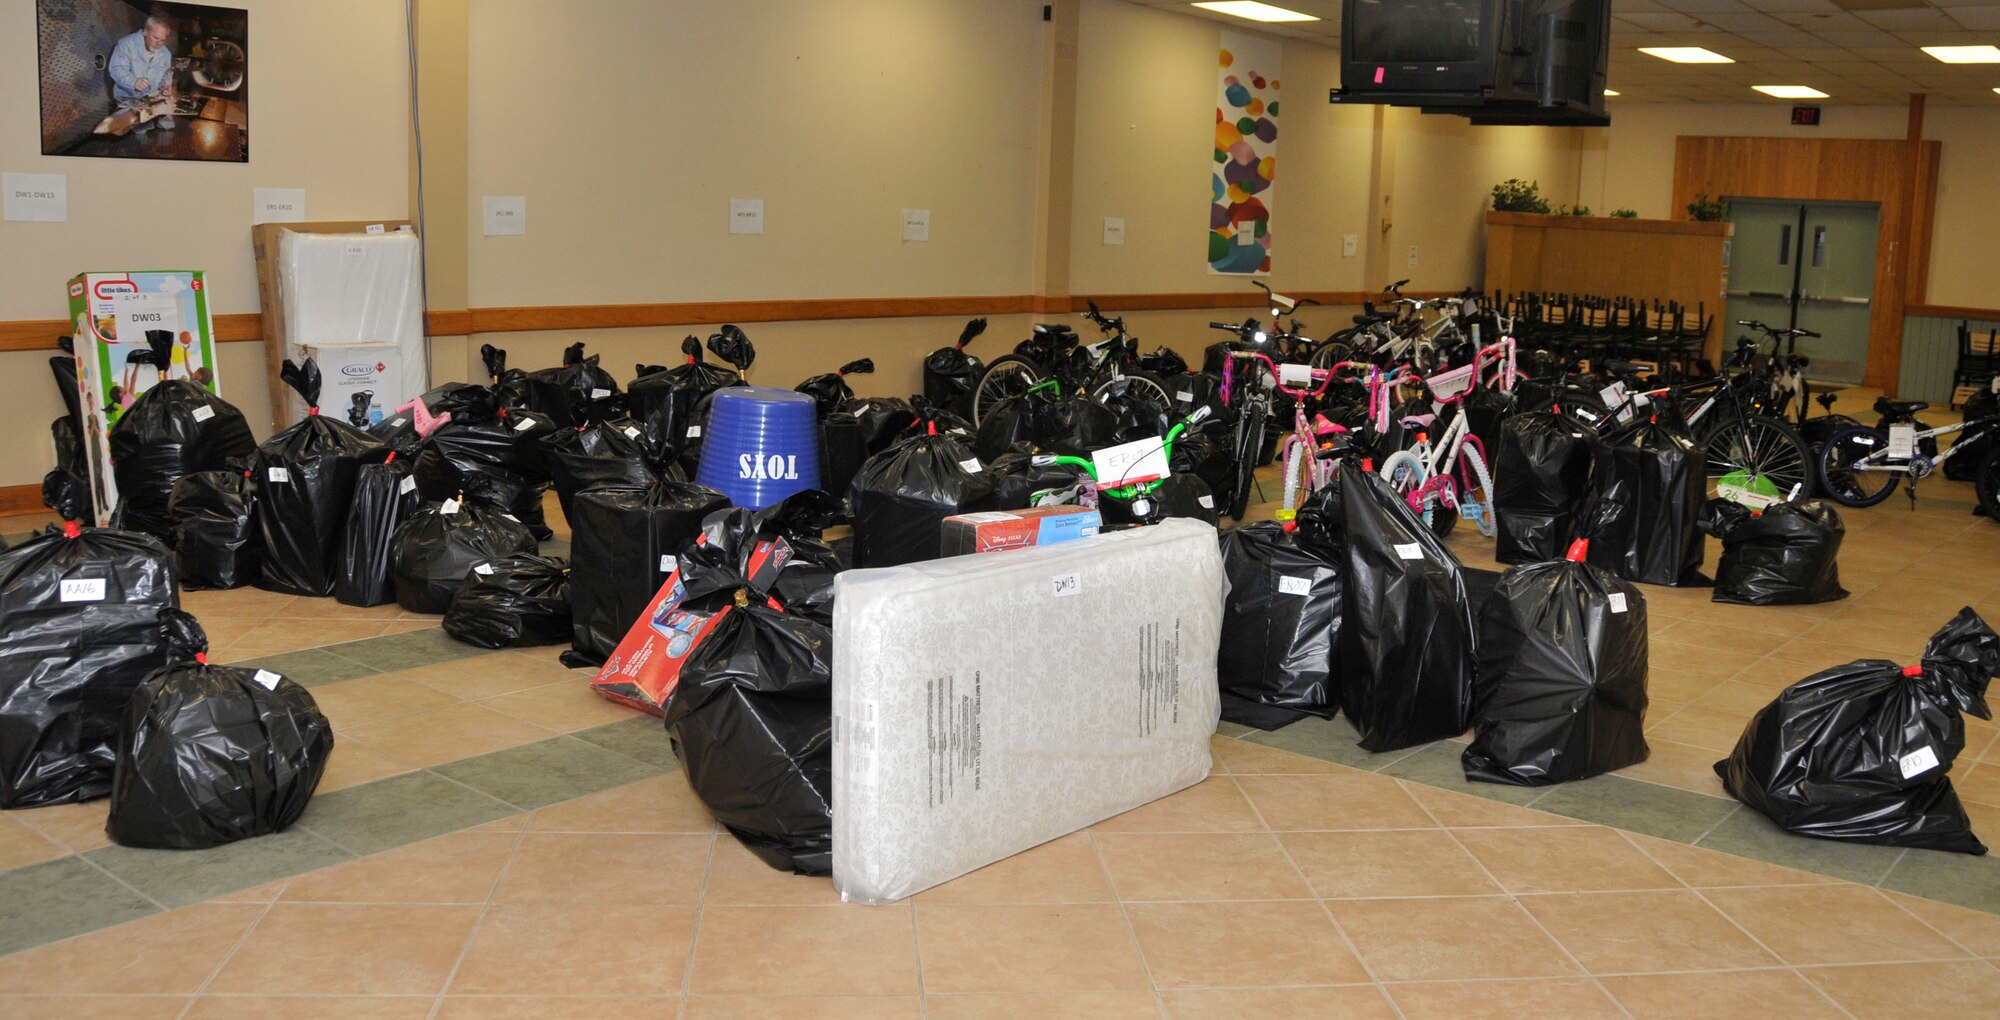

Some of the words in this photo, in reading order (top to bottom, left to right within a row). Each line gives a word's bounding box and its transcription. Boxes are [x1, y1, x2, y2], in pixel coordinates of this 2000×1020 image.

[15, 191, 55, 199] DW1-DW13
[131, 313, 162, 322] DW03
[739, 453, 798, 480] TOYS
[992, 535, 1006, 543] Disney
